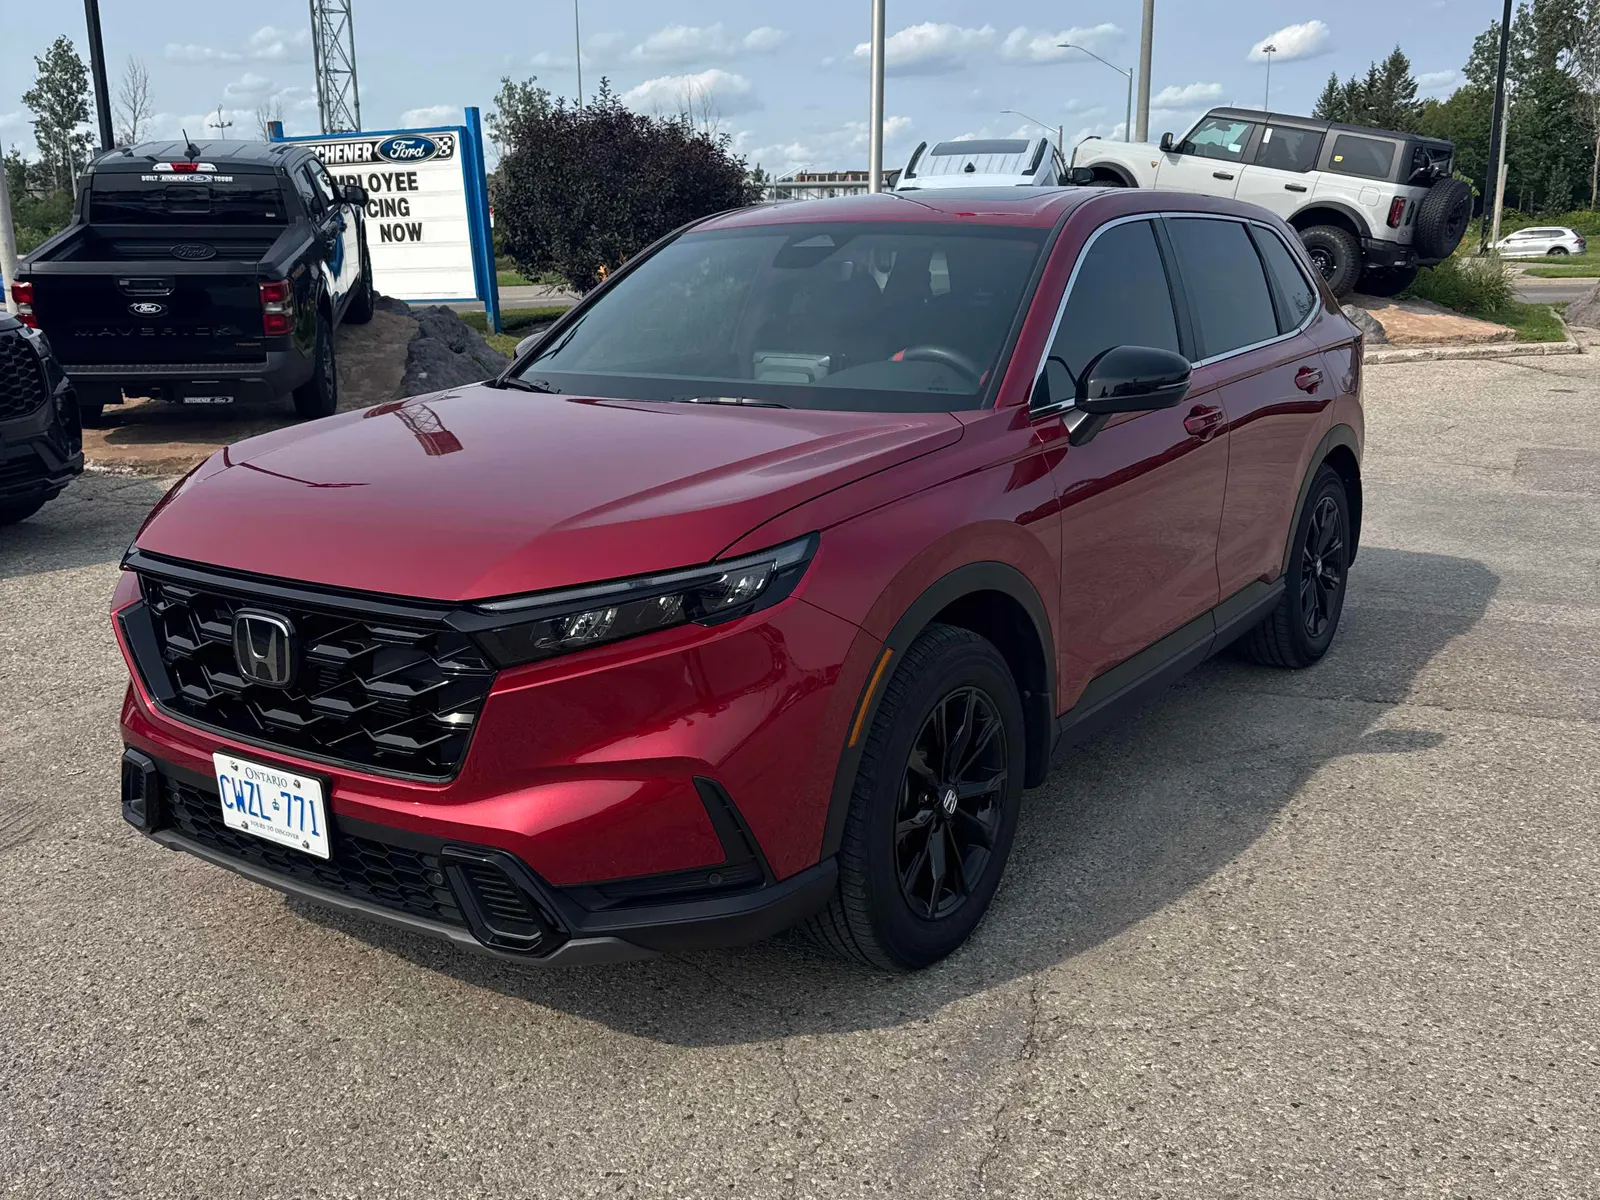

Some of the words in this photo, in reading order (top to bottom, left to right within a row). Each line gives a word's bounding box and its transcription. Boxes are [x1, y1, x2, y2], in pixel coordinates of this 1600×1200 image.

[308, 142, 373, 164] CHENER
[390, 140, 425, 158] Ford
[331, 172, 419, 192] MPLOYEE
[362, 197, 410, 219] CING
[380, 222, 422, 243] NOW
[178, 245, 208, 258] Ford
[74, 327, 231, 336] MAVERICK
[245, 766, 288, 788] ONTARIO
[220, 774, 272, 822] CWZL
[280, 790, 321, 837] 771
[250, 820, 266, 830] YOURS
[275, 827, 300, 840] DISCOVER
